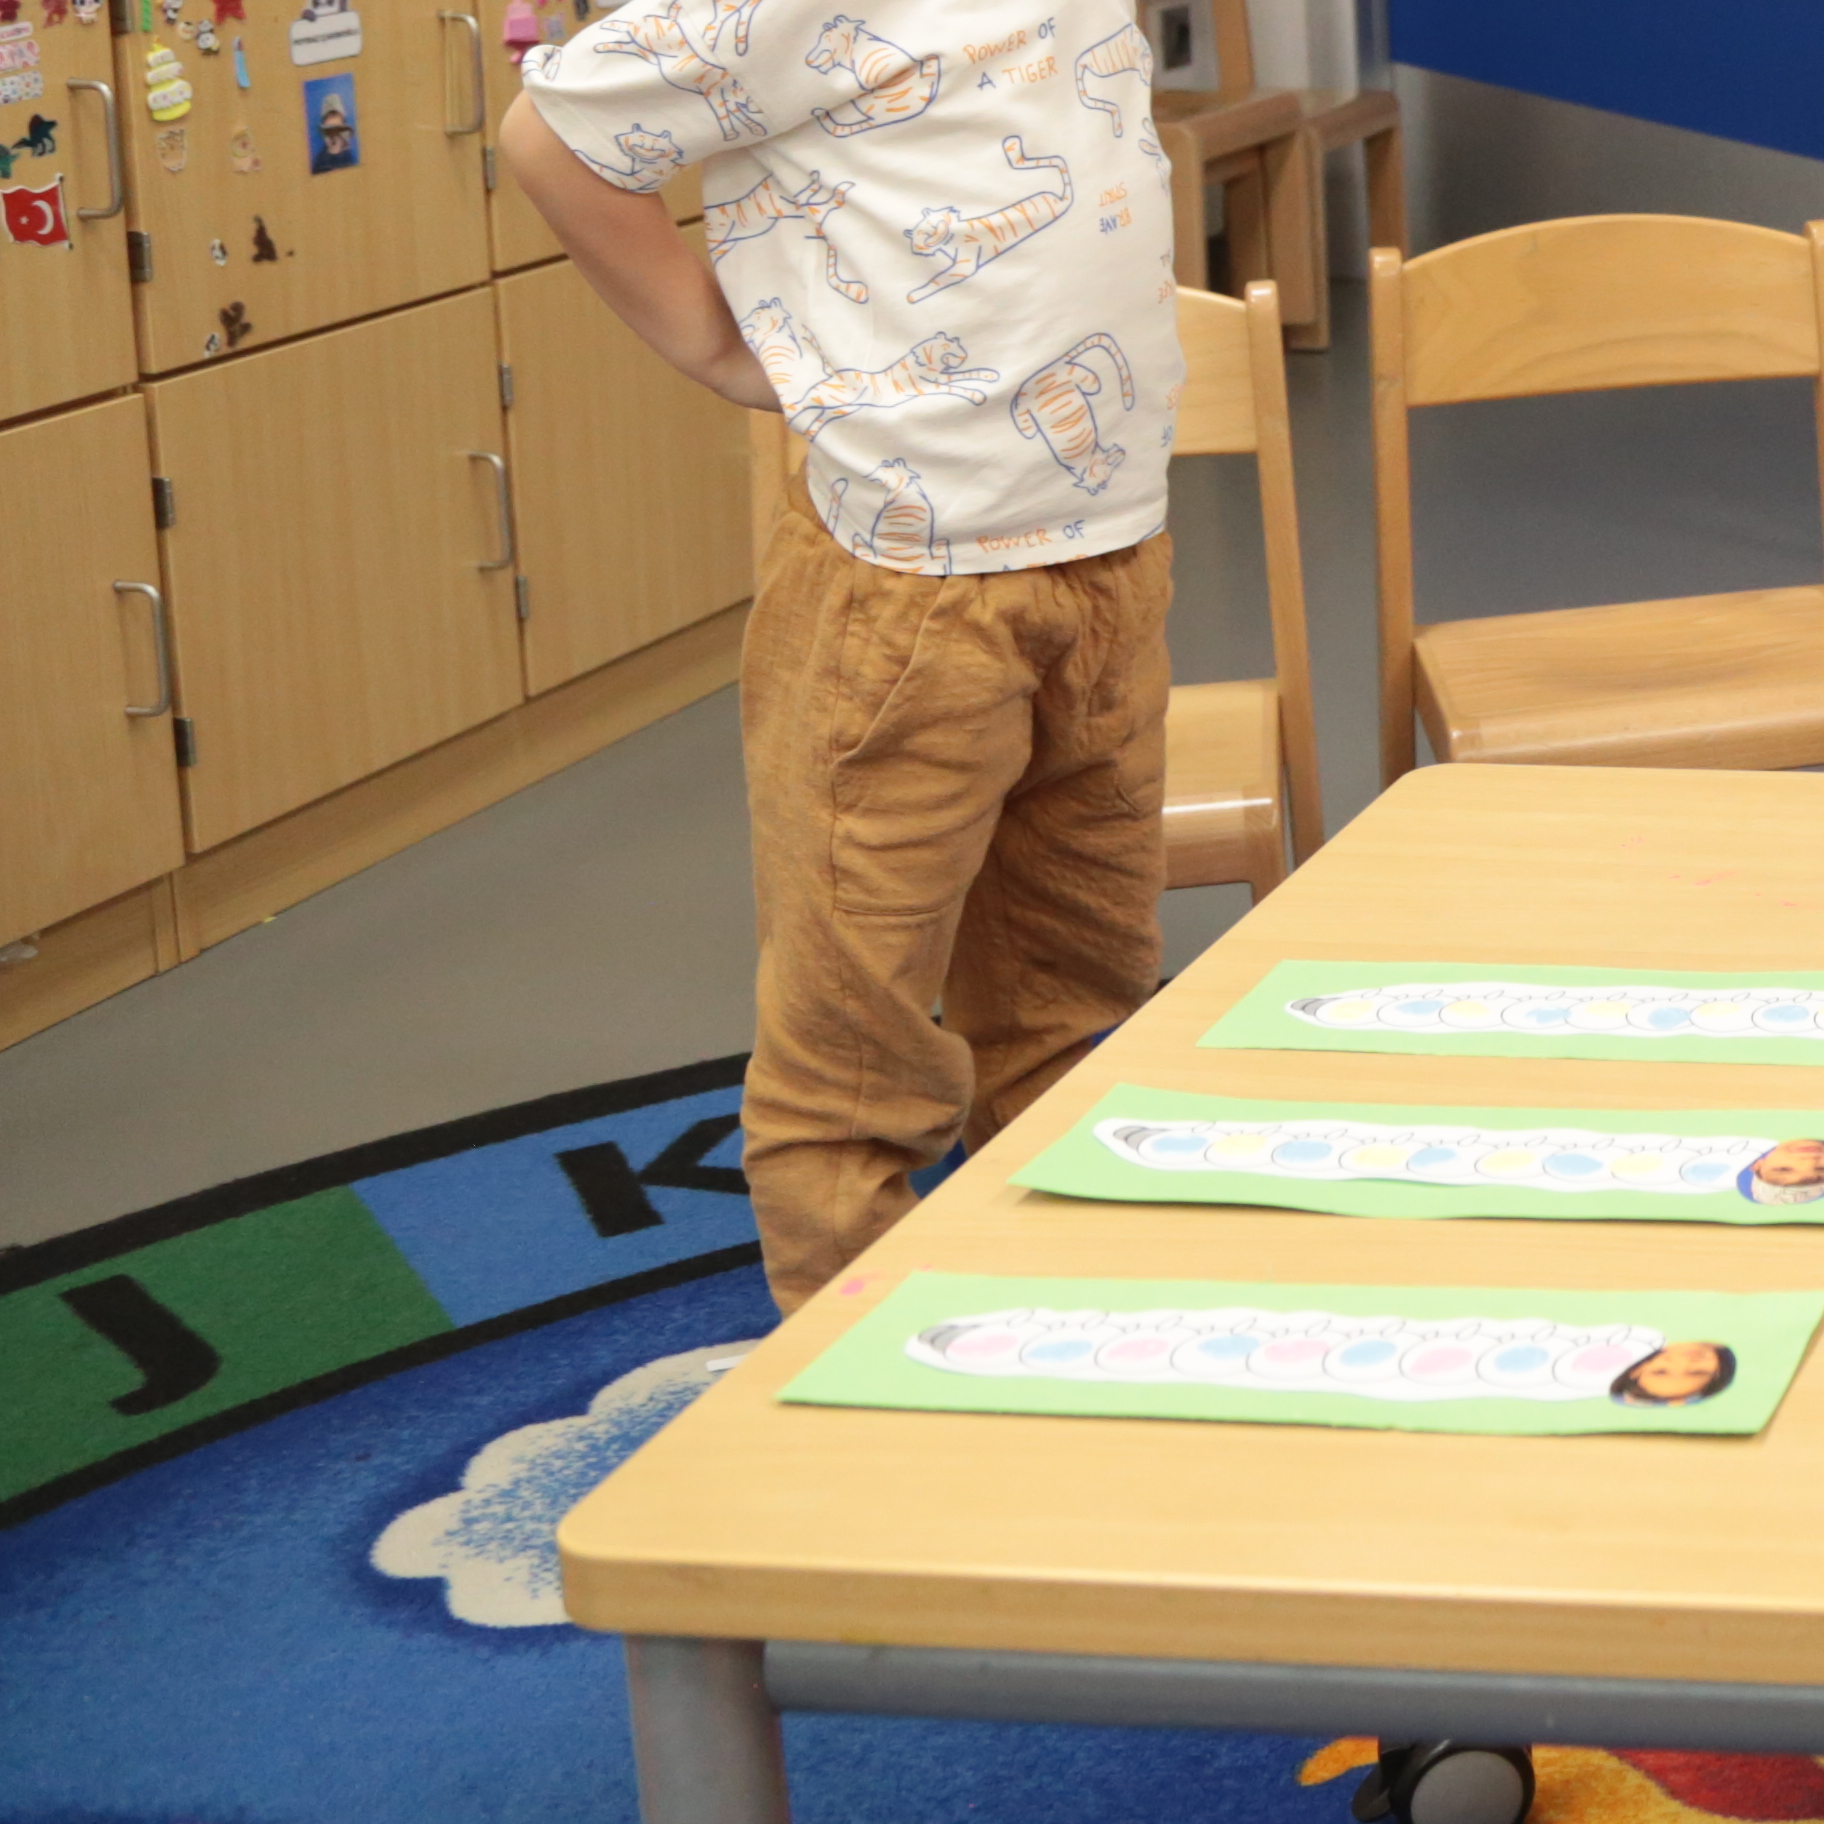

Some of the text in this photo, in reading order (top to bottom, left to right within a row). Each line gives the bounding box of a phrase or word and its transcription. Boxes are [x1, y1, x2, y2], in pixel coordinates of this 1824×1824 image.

[963, 17, 1056, 65] POWER OF
[977, 56, 1059, 91] A TIGER
[976, 519, 1086, 554] POWER OF
[555, 1113, 749, 1238] K
[57, 1273, 222, 1416] J
